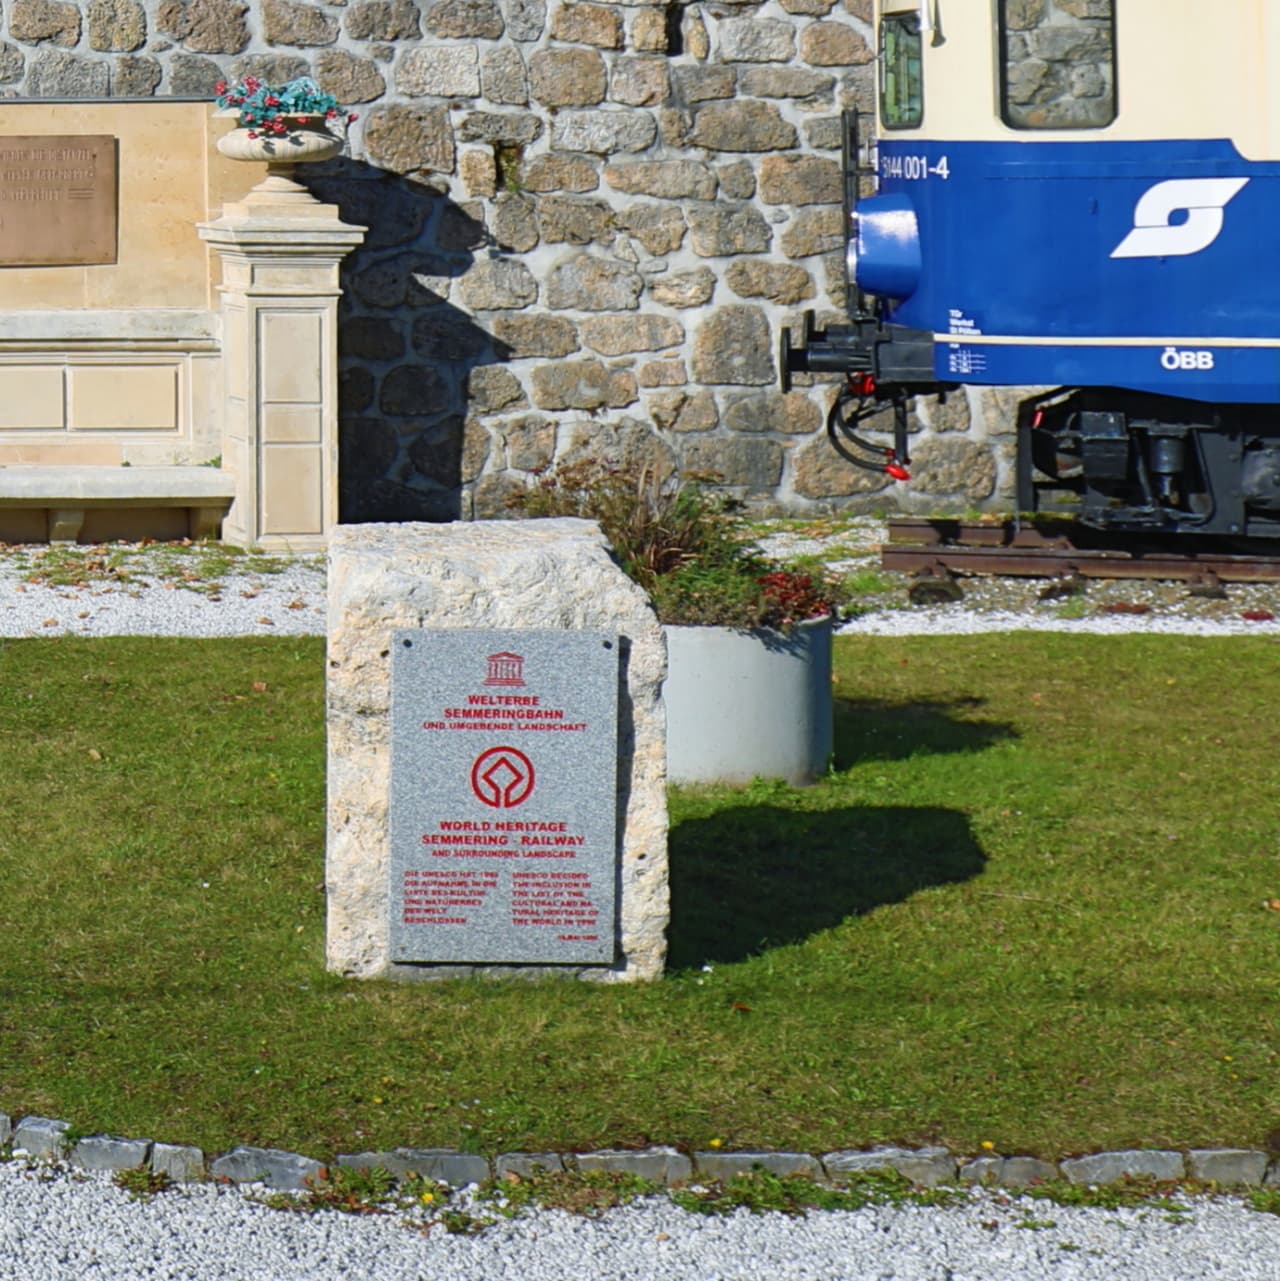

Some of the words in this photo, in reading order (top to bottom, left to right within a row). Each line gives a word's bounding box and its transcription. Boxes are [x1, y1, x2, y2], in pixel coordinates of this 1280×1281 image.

[903, 156, 950, 179] 001-4
[1160, 347, 1214, 370] ÖBB
[468, 695, 540, 706] WELTERBE
[444, 708, 564, 719] SEMMERINGBAHN
[423, 722, 446, 731] UND
[449, 722, 514, 731] UMGEBENDE
[518, 722, 587, 731] LANDSCHAFT
[440, 821, 491, 832] WORLD
[495, 821, 568, 832] HERITAGE
[421, 835, 509, 845] SEMMERING
[521, 835, 585, 845] RAILWAY
[432, 850, 451, 858] AND
[453, 850, 519, 858] SURROUNDING
[522, 850, 576, 858] LANDSCAPE
